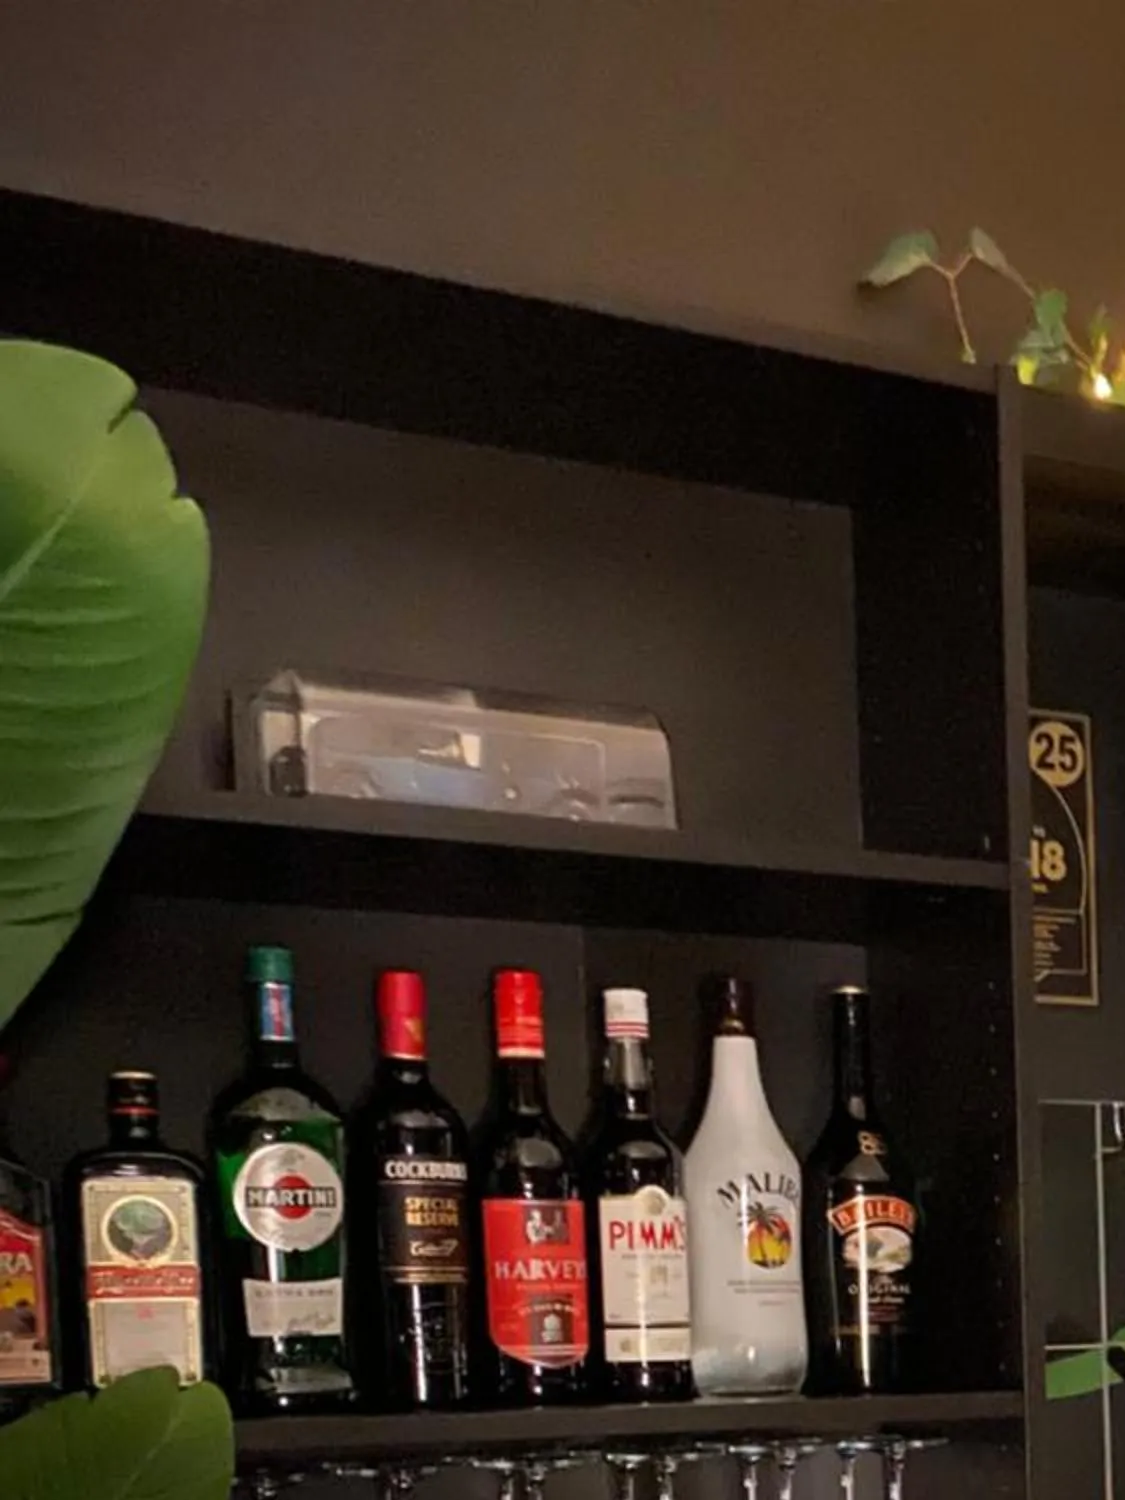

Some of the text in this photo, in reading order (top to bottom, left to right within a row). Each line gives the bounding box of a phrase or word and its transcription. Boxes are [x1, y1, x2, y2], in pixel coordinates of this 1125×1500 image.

[1034, 731, 1079, 773] 25
[1029, 838, 1068, 882] 18
[246, 1187, 336, 1208] MARTINI
